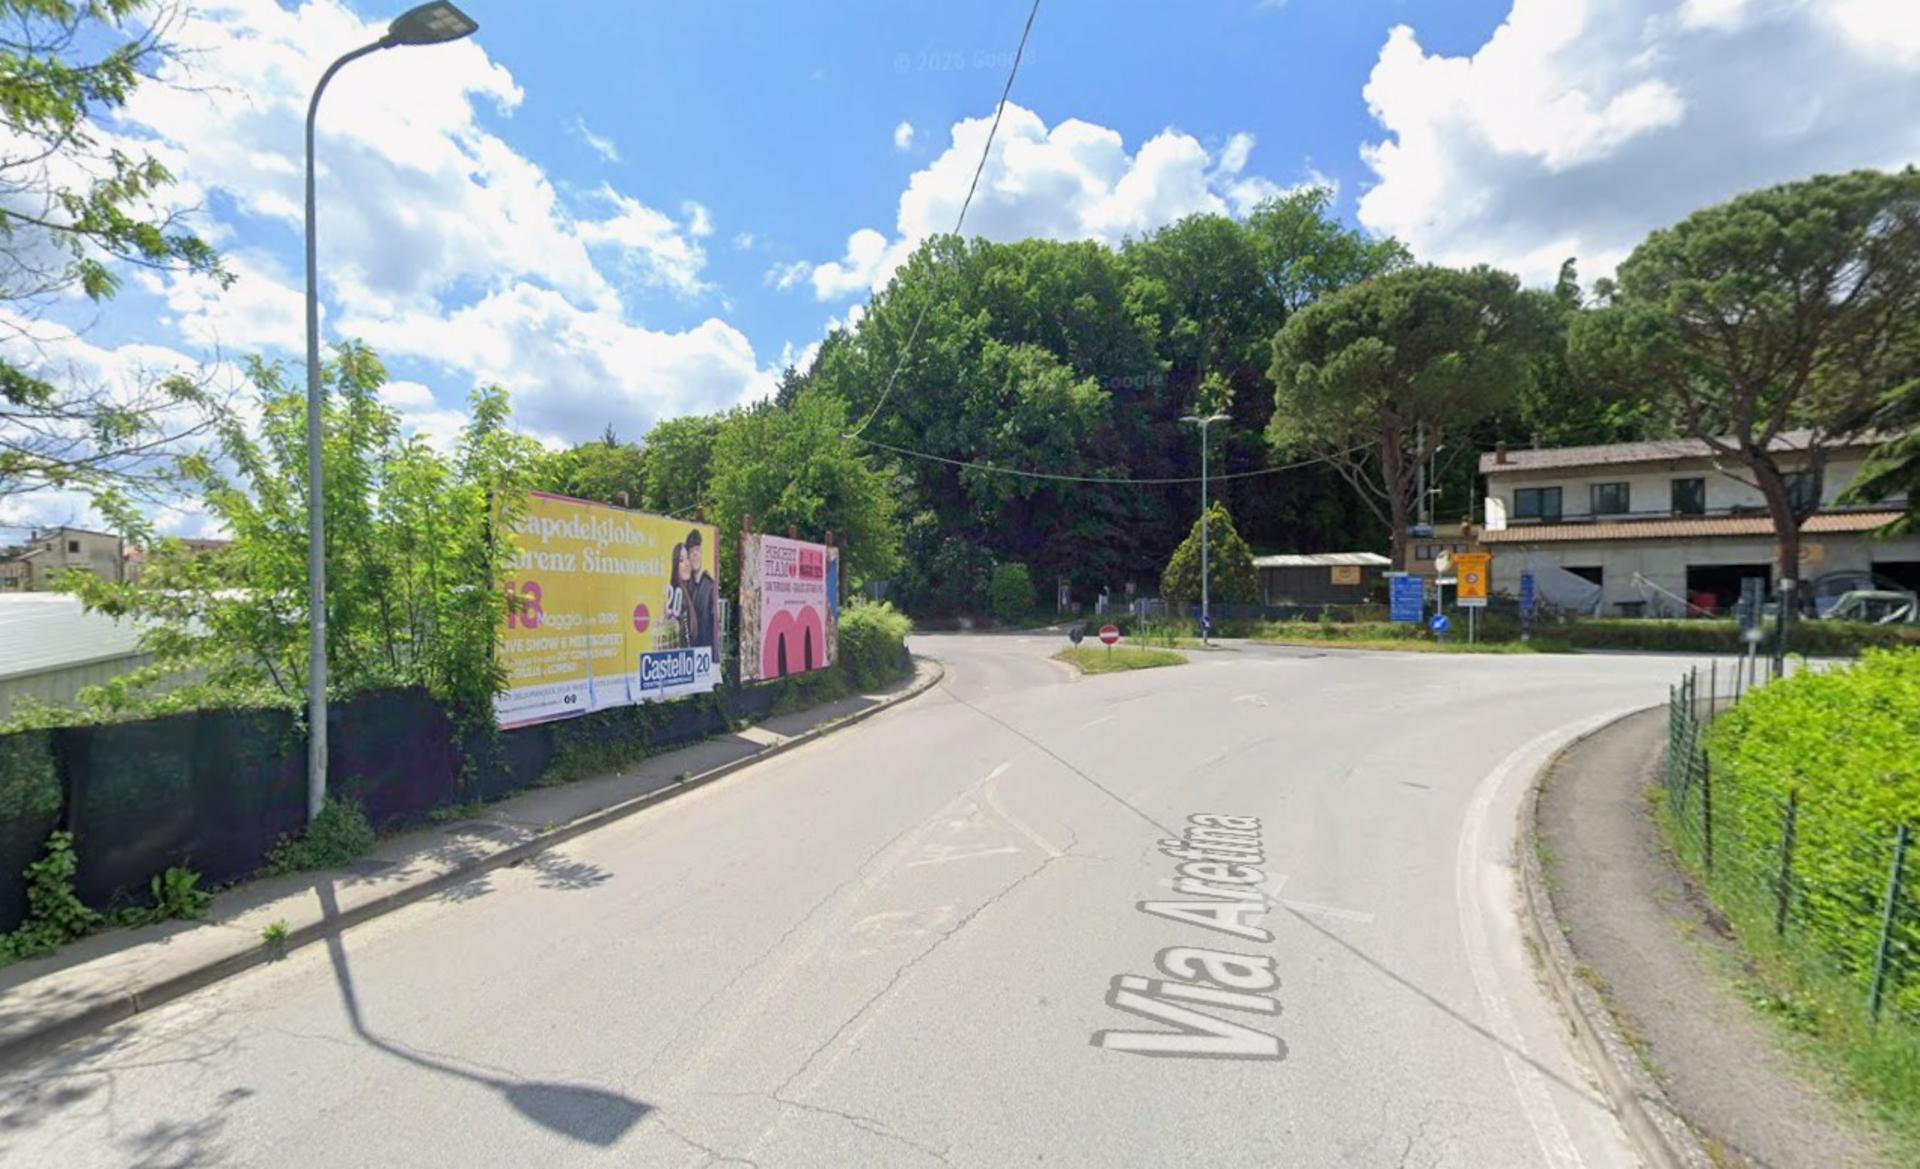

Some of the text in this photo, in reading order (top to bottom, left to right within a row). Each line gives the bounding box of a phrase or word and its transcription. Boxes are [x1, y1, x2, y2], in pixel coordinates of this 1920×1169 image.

[665, 584, 683, 617] 20
[642, 652, 693, 681] Castello
[697, 652, 711, 673] 20
